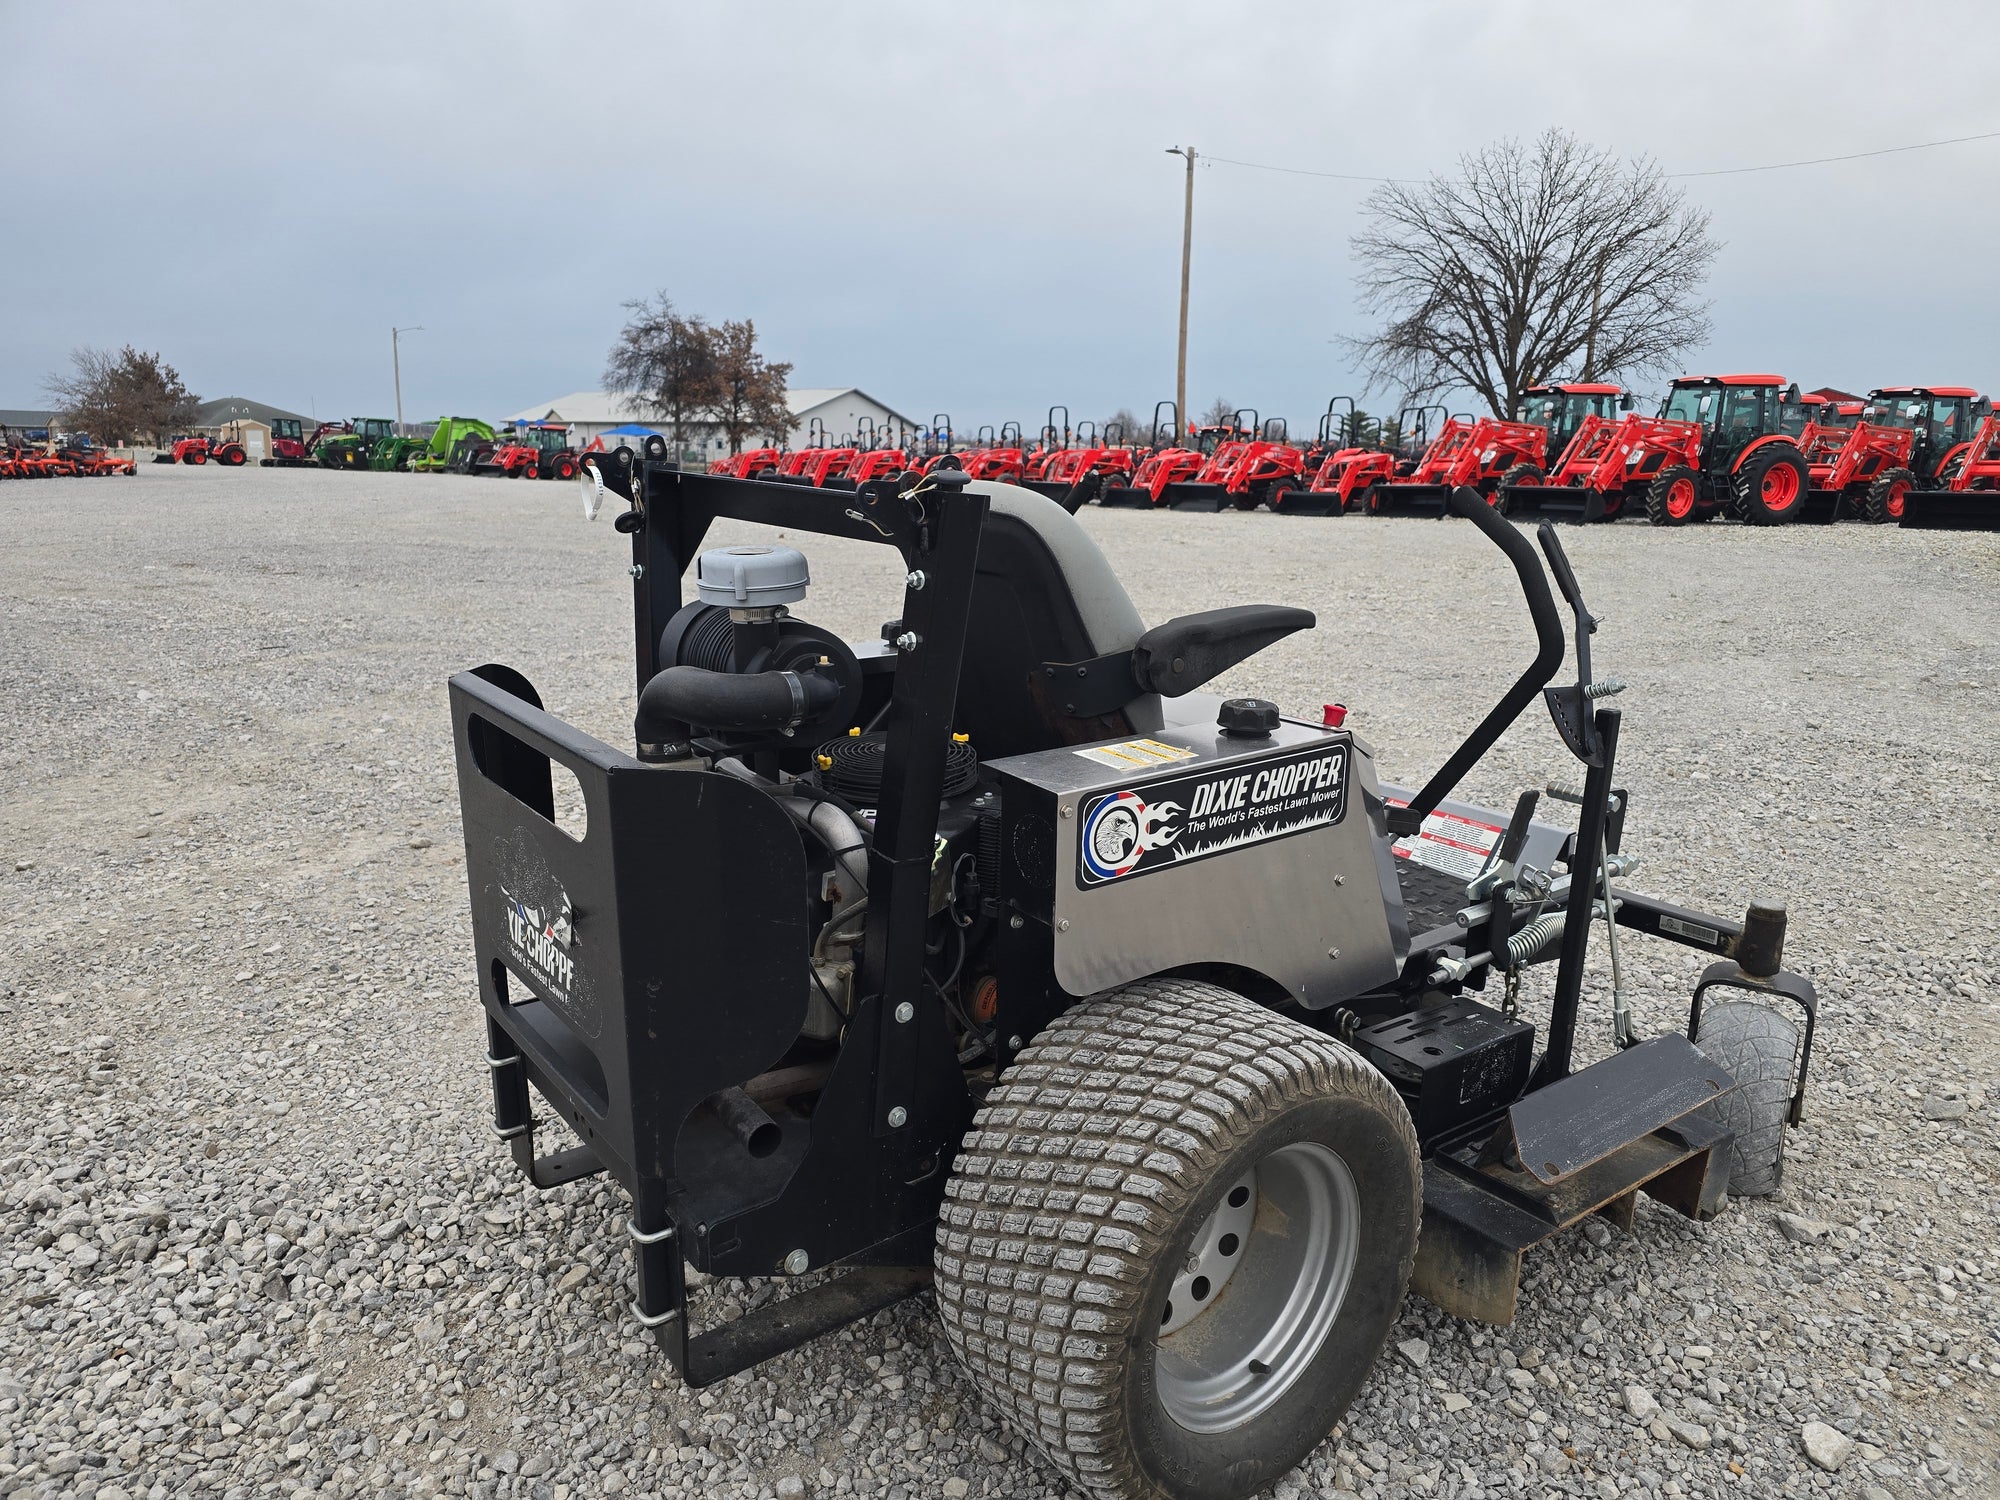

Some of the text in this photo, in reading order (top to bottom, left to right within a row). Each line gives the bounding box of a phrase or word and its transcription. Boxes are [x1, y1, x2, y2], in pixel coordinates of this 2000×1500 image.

[1187, 788, 1341, 834] The World's Fastest Lawn Mower
[1189, 754, 1342, 819] DIXIE CHOPPER
[510, 946, 527, 967] orld's
[526, 959, 548, 987] Fastest
[548, 978, 565, 1004] Lawn
